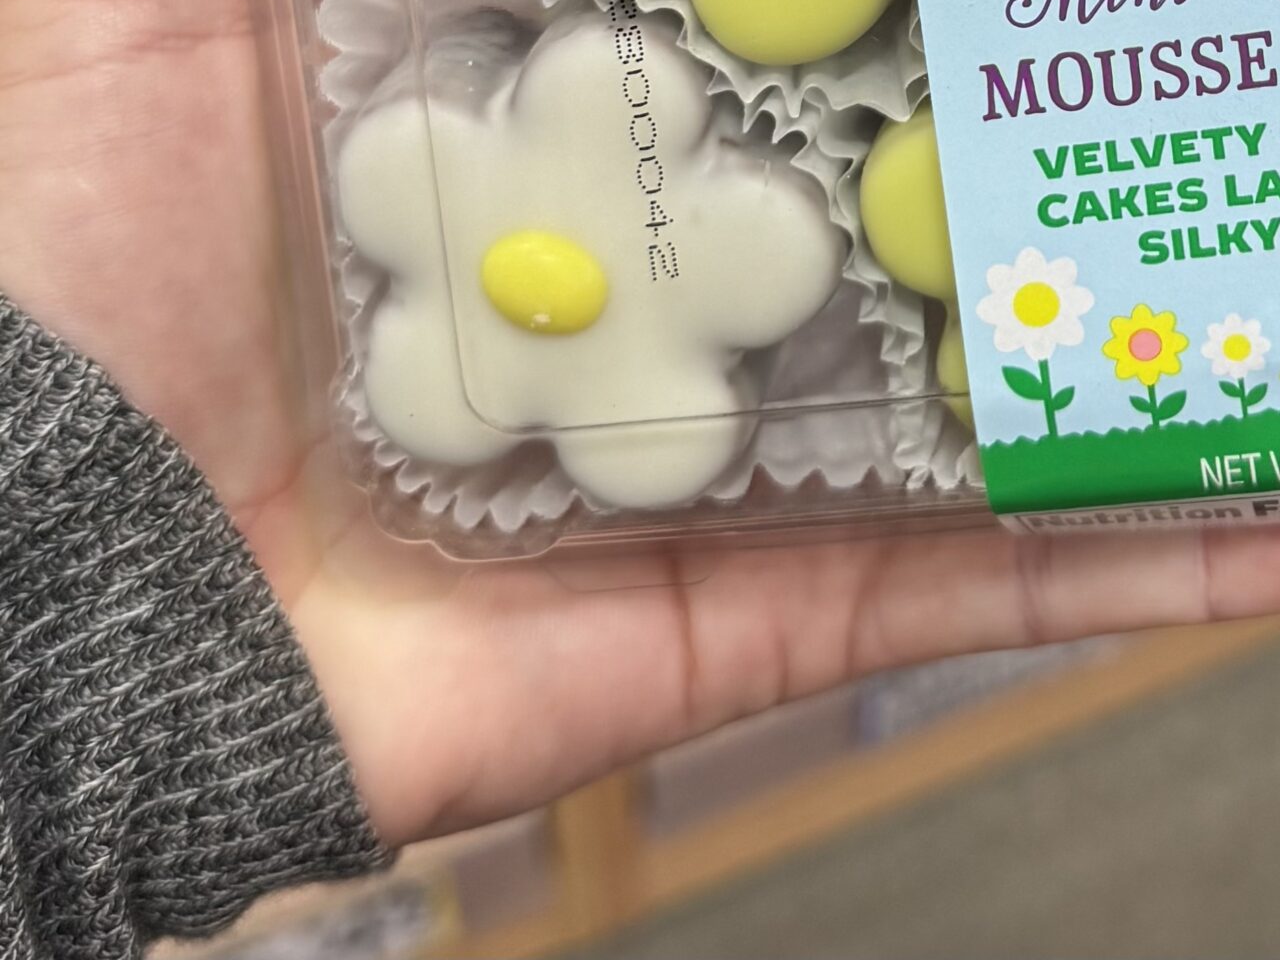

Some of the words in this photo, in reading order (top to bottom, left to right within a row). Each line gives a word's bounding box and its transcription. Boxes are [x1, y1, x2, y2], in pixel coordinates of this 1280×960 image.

[979, 30, 1278, 122] MOUSSE
[1033, 122, 1266, 180] VELVETY
[1037, 178, 1208, 229] CAKES
[1200, 453, 1261, 489] NET
[1028, 503, 1243, 530] Nutrition
